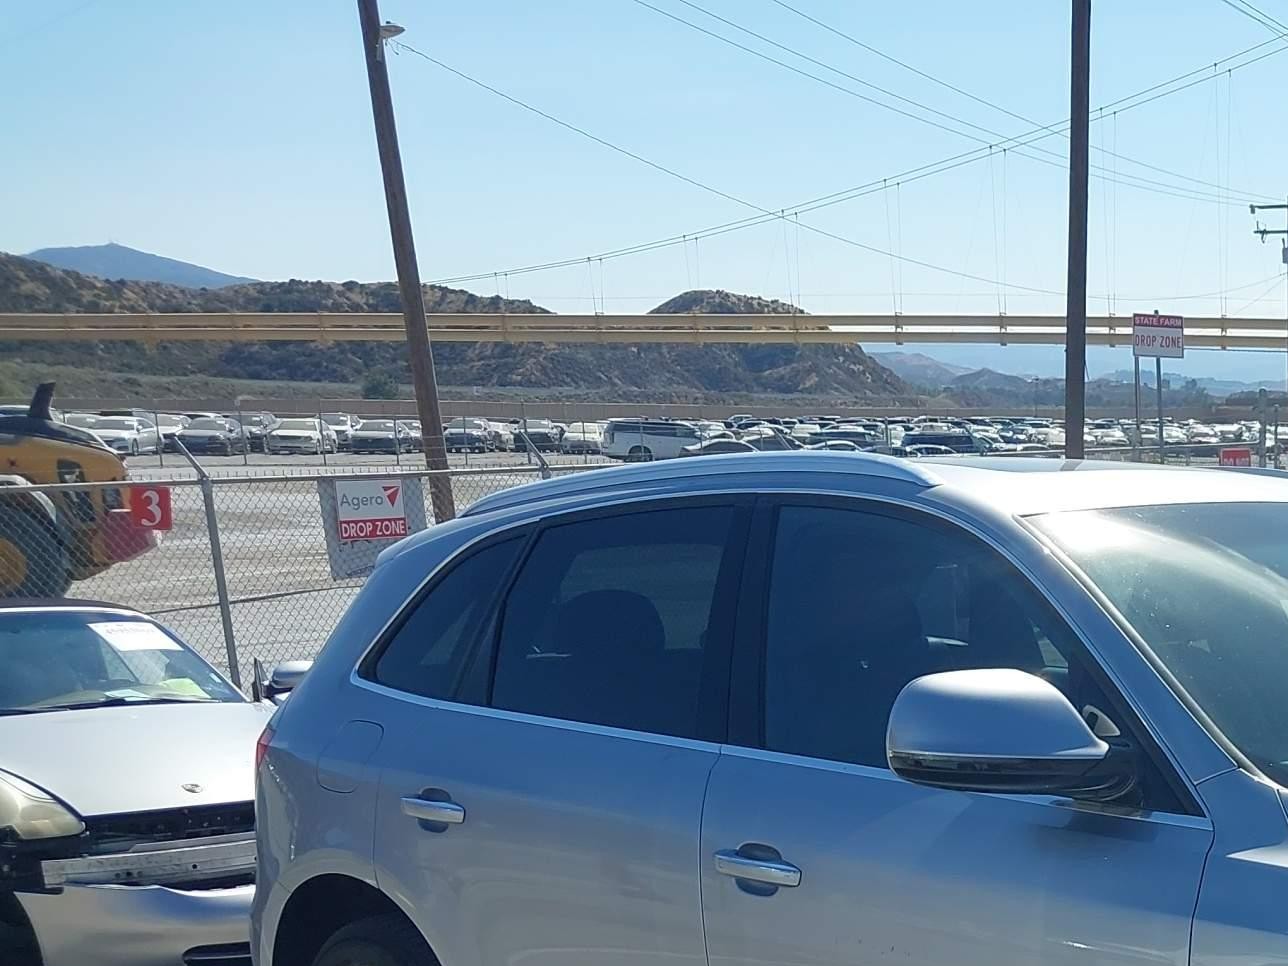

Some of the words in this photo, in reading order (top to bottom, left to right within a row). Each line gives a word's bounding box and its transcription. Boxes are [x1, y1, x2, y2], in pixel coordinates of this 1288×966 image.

[1135, 316, 1158, 325] STATE
[1160, 318, 1182, 327] FARM
[1136, 334, 1157, 347] DROP
[1160, 336, 1181, 348] ZONE
[141, 490, 162, 527] 3
[340, 493, 384, 510] Agero
[341, 521, 373, 537] DROP
[376, 520, 405, 536] ZONE
